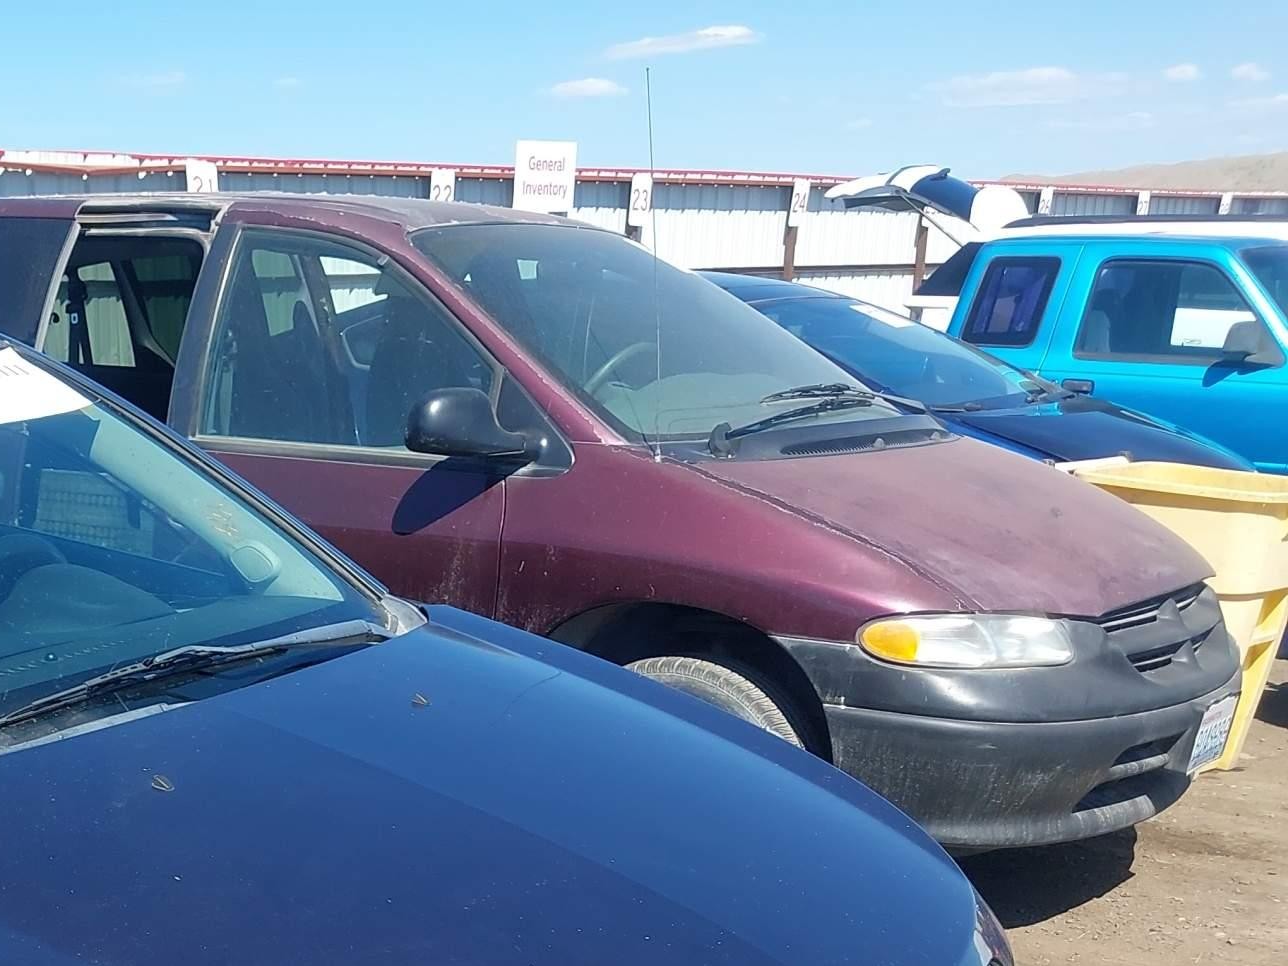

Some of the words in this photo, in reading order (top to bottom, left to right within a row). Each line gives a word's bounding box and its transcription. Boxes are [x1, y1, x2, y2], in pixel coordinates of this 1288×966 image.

[528, 156, 566, 172] General
[522, 180, 568, 199] Inventory
[631, 188, 649, 211] 23
[792, 191, 807, 213] 24
